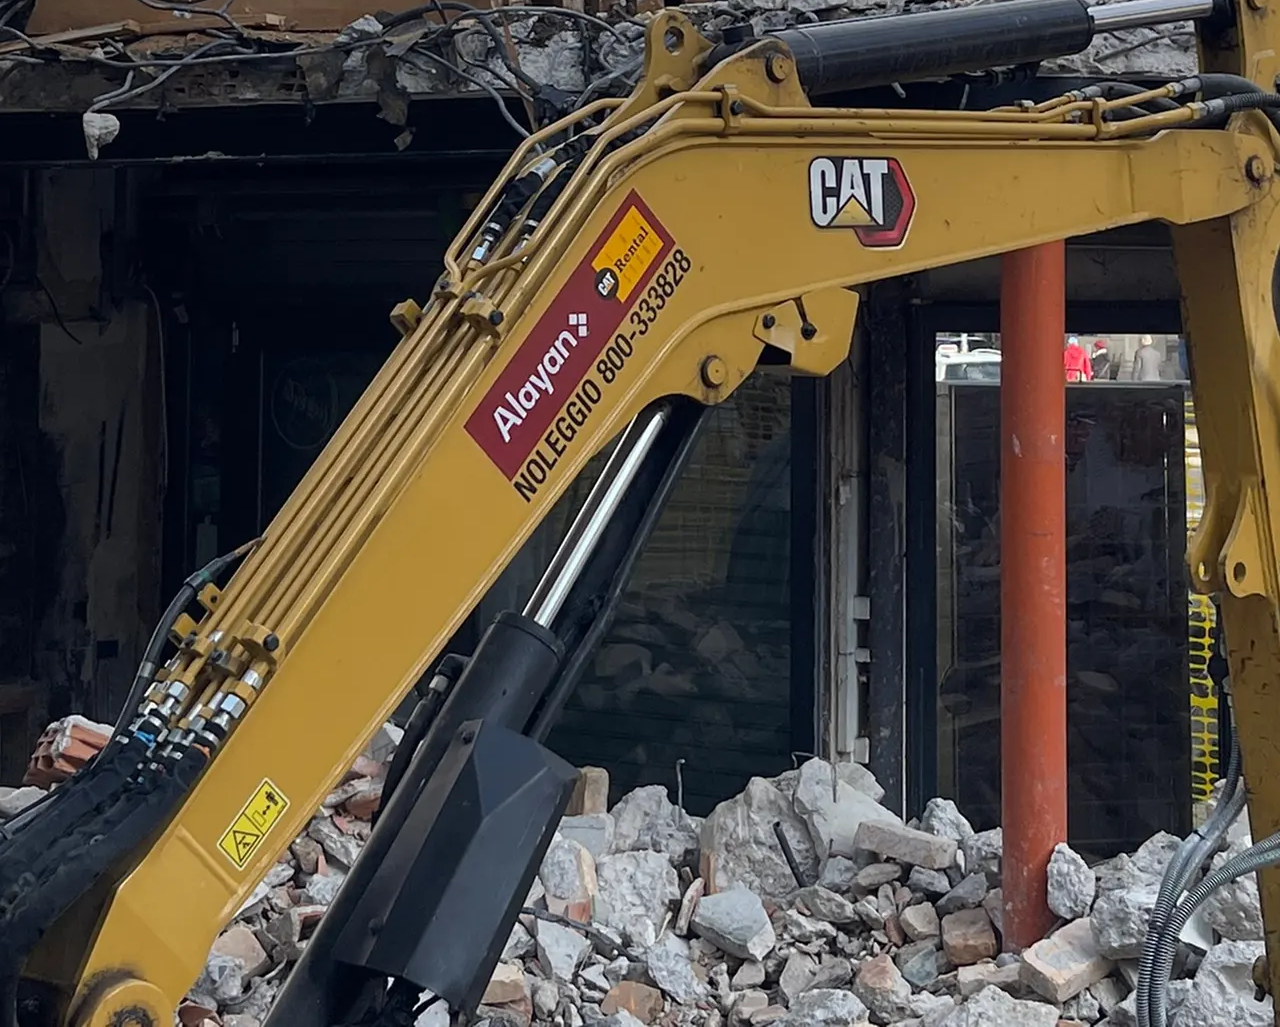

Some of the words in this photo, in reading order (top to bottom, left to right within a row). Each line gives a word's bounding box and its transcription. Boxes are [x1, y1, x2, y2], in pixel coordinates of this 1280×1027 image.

[810, 157, 888, 226] CAT
[597, 271, 616, 296] CAT
[615, 226, 648, 273] Rental
[493, 327, 577, 443] Alayan
[513, 378, 602, 503] NOLEGGIO
[600, 248, 692, 385] 800-333828
